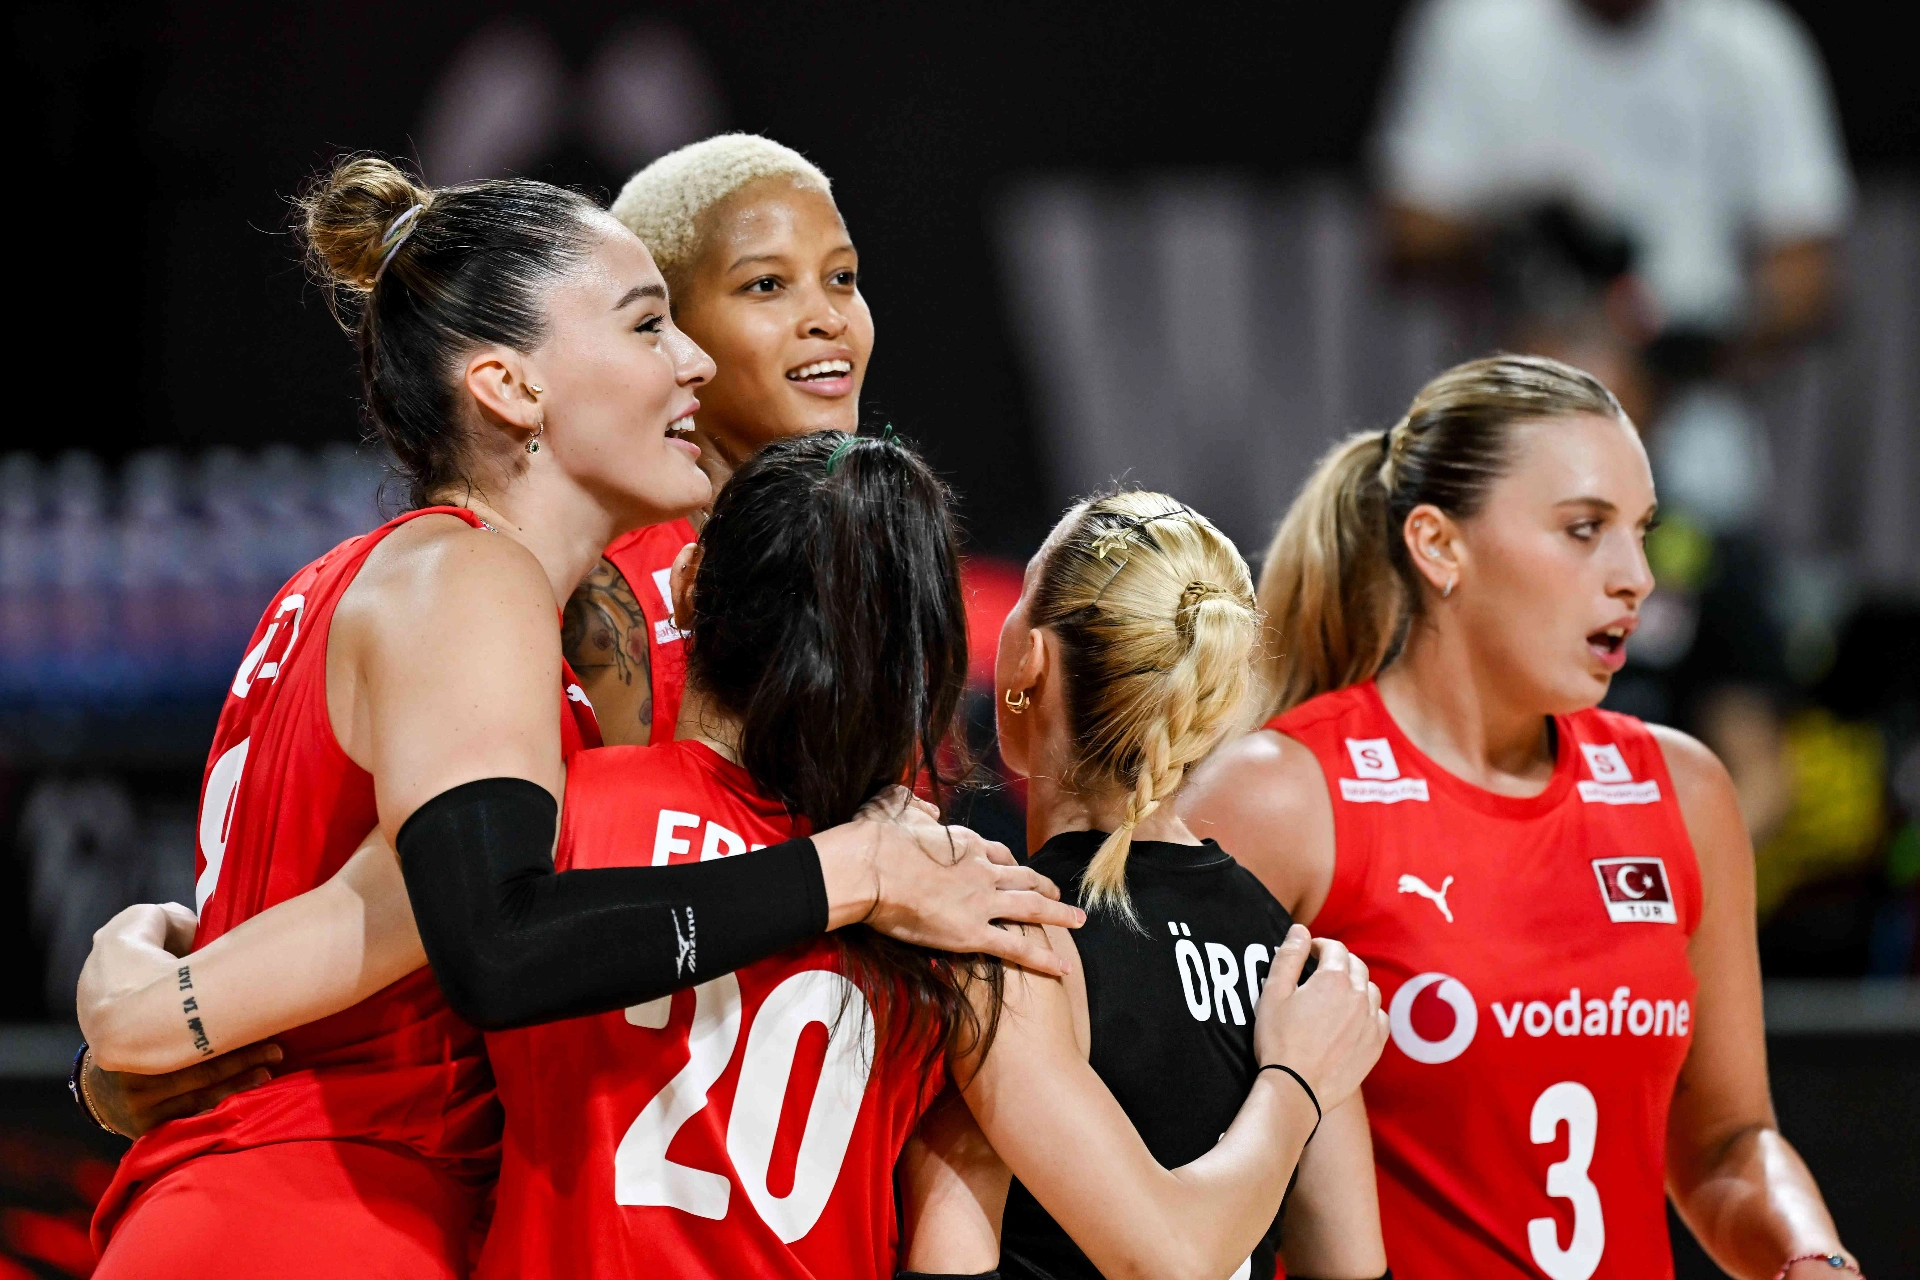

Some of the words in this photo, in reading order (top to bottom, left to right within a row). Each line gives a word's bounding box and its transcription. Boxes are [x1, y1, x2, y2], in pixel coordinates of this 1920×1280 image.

[1361, 748, 1383, 769] S
[1593, 753, 1616, 775] S
[1626, 905, 1663, 918] TUR
[1167, 921, 1278, 1026] ÖRG
[1491, 986, 1690, 1038] vodafone
[614, 969, 875, 1245] 20
[1527, 1081, 1605, 1280] 3
